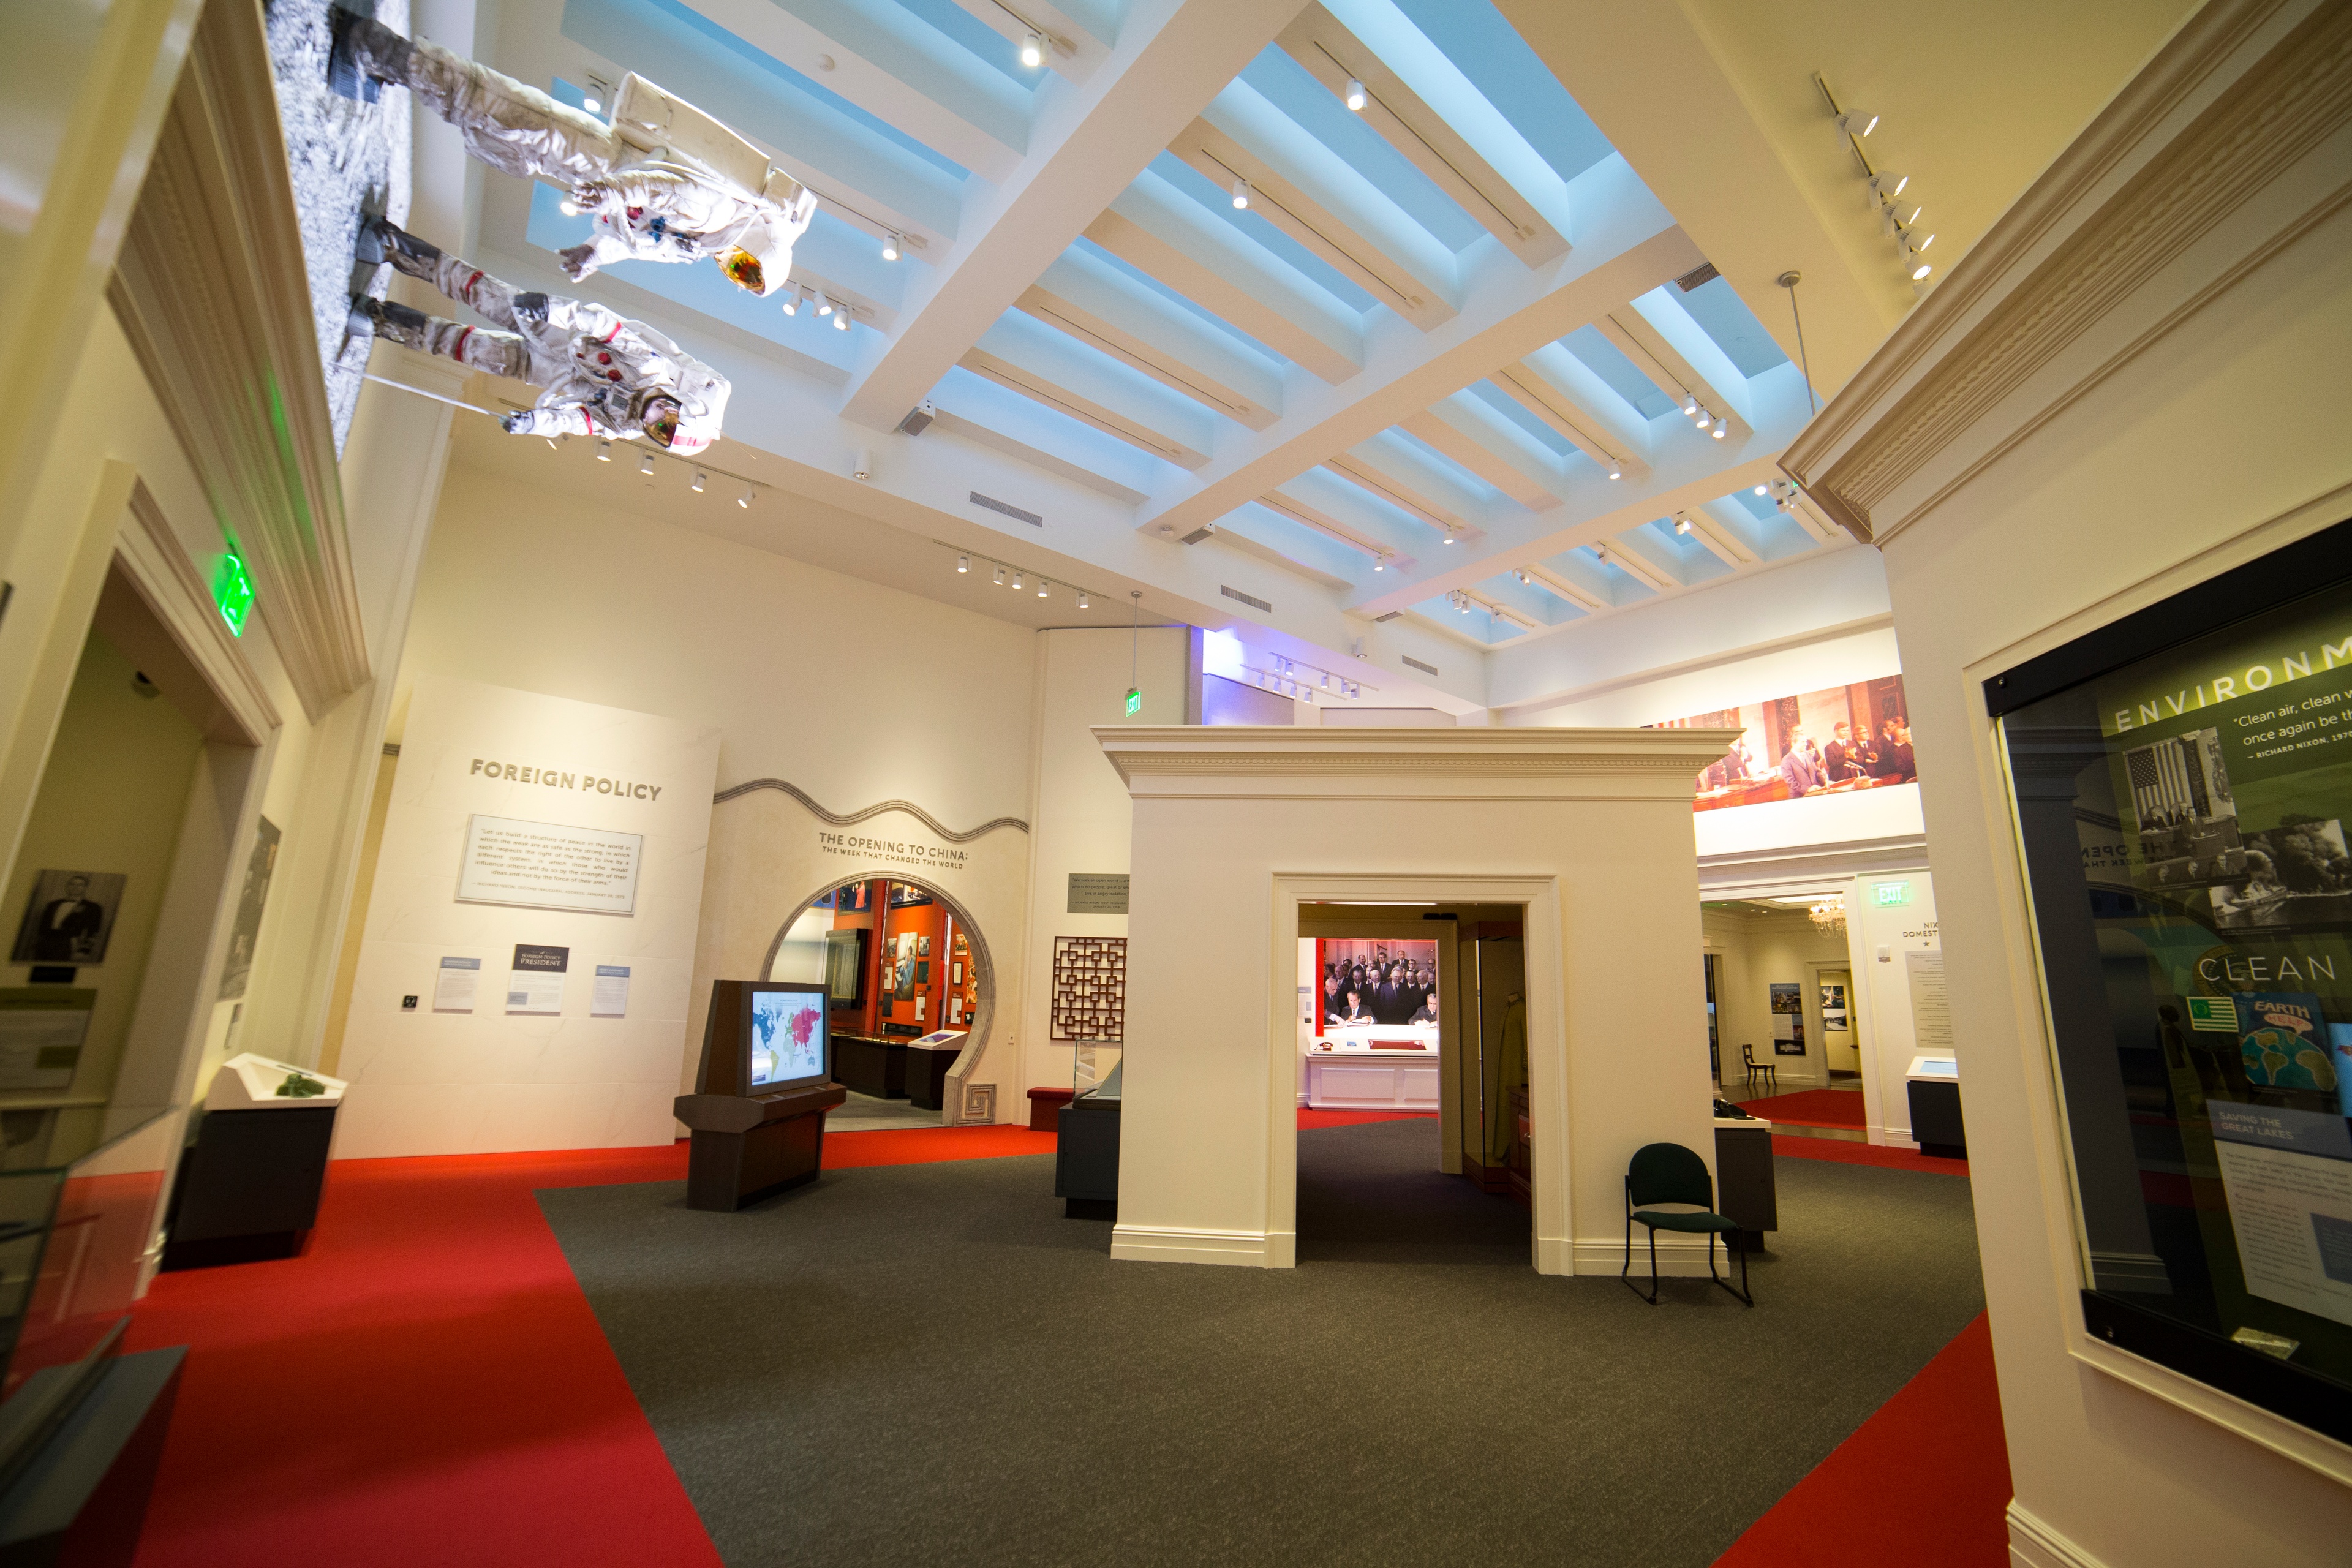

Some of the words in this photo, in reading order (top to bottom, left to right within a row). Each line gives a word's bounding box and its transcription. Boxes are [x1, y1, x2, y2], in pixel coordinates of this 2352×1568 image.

[2234, 711, 2275, 726] "Clean
[2278, 704, 2298, 717] air,
[2301, 693, 2341, 710] clean
[2243, 731, 2275, 745] once
[2278, 720, 2316, 737] again
[2318, 715, 2339, 727] be
[2256, 745, 2294, 758] RICHARD
[2296, 737, 2329, 749] NIXON,
[470, 758, 575, 789] FOREIGN
[582, 775, 662, 801] POLICY
[819, 832, 844, 845] THE
[848, 837, 904, 853] OPENING
[908, 845, 924, 855] TO
[929, 848, 968, 861] CHINA:
[885, 854, 919, 864] CHANGED
[938, 861, 963, 869] WORLD
[1879, 886, 1902, 902] EXIT
[2199, 956, 2335, 981] CLEAN
[2254, 1001, 2311, 1019] EARTH
[2219, 1112, 2258, 1125] SAVING
[2261, 1117, 2282, 1128] THE
[2220, 1122, 2254, 1133] GREAT
[2258, 1128, 2294, 1140] LAKES
